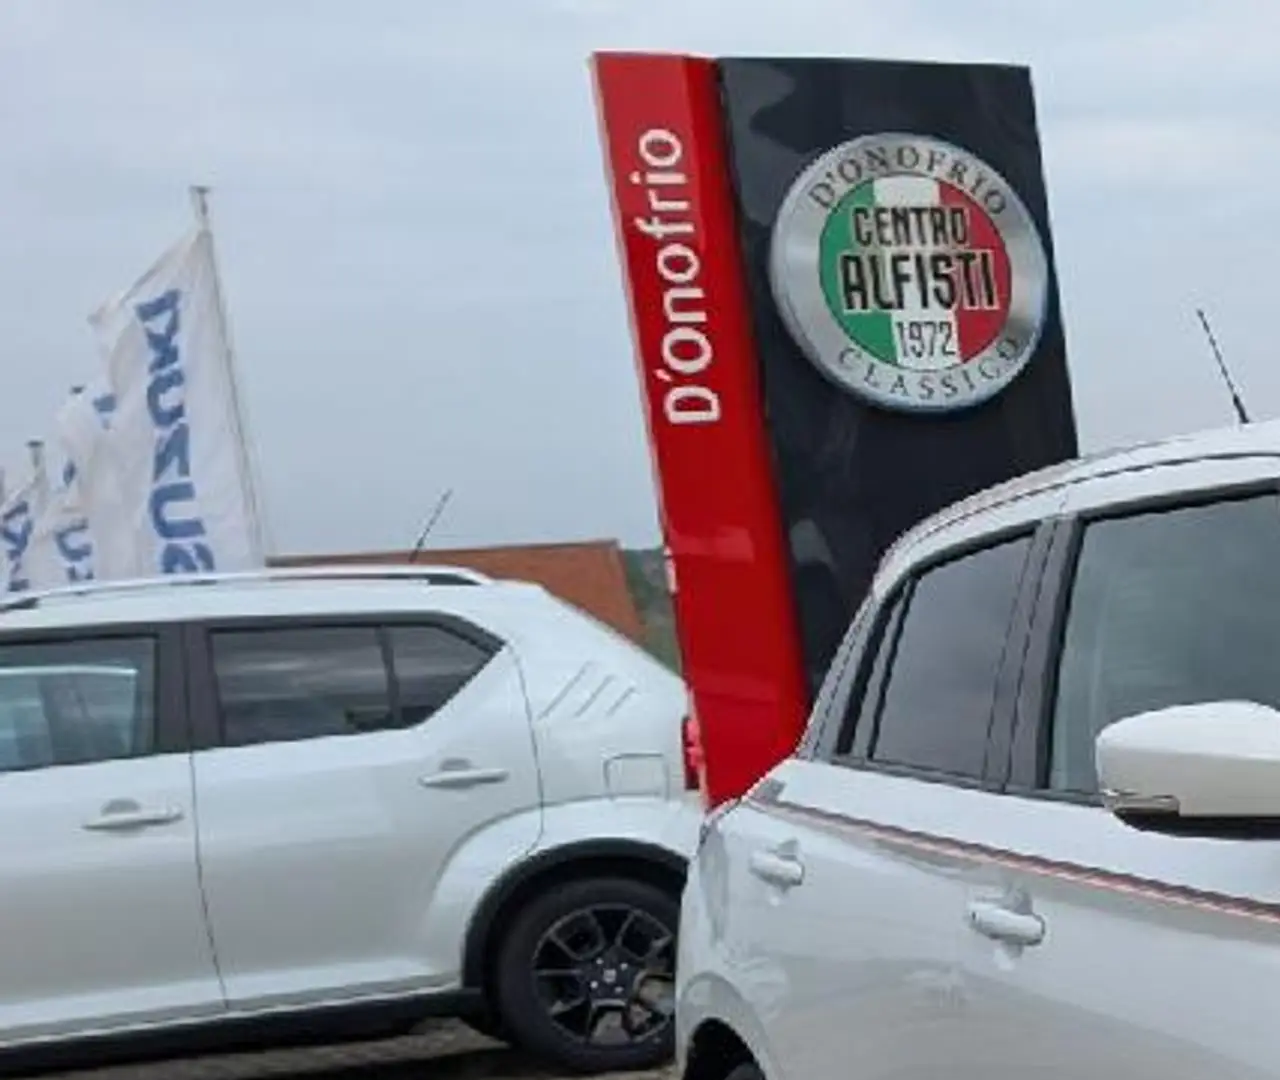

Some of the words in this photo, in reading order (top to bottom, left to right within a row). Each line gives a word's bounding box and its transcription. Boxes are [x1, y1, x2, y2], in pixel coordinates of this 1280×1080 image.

[808, 145, 1007, 215] D'ONOFRIO
[852, 206, 969, 247] CENTRO
[840, 252, 997, 310] ALFISTI
[898, 321, 956, 358] 1972
[839, 338, 1021, 400] CLASSICO
